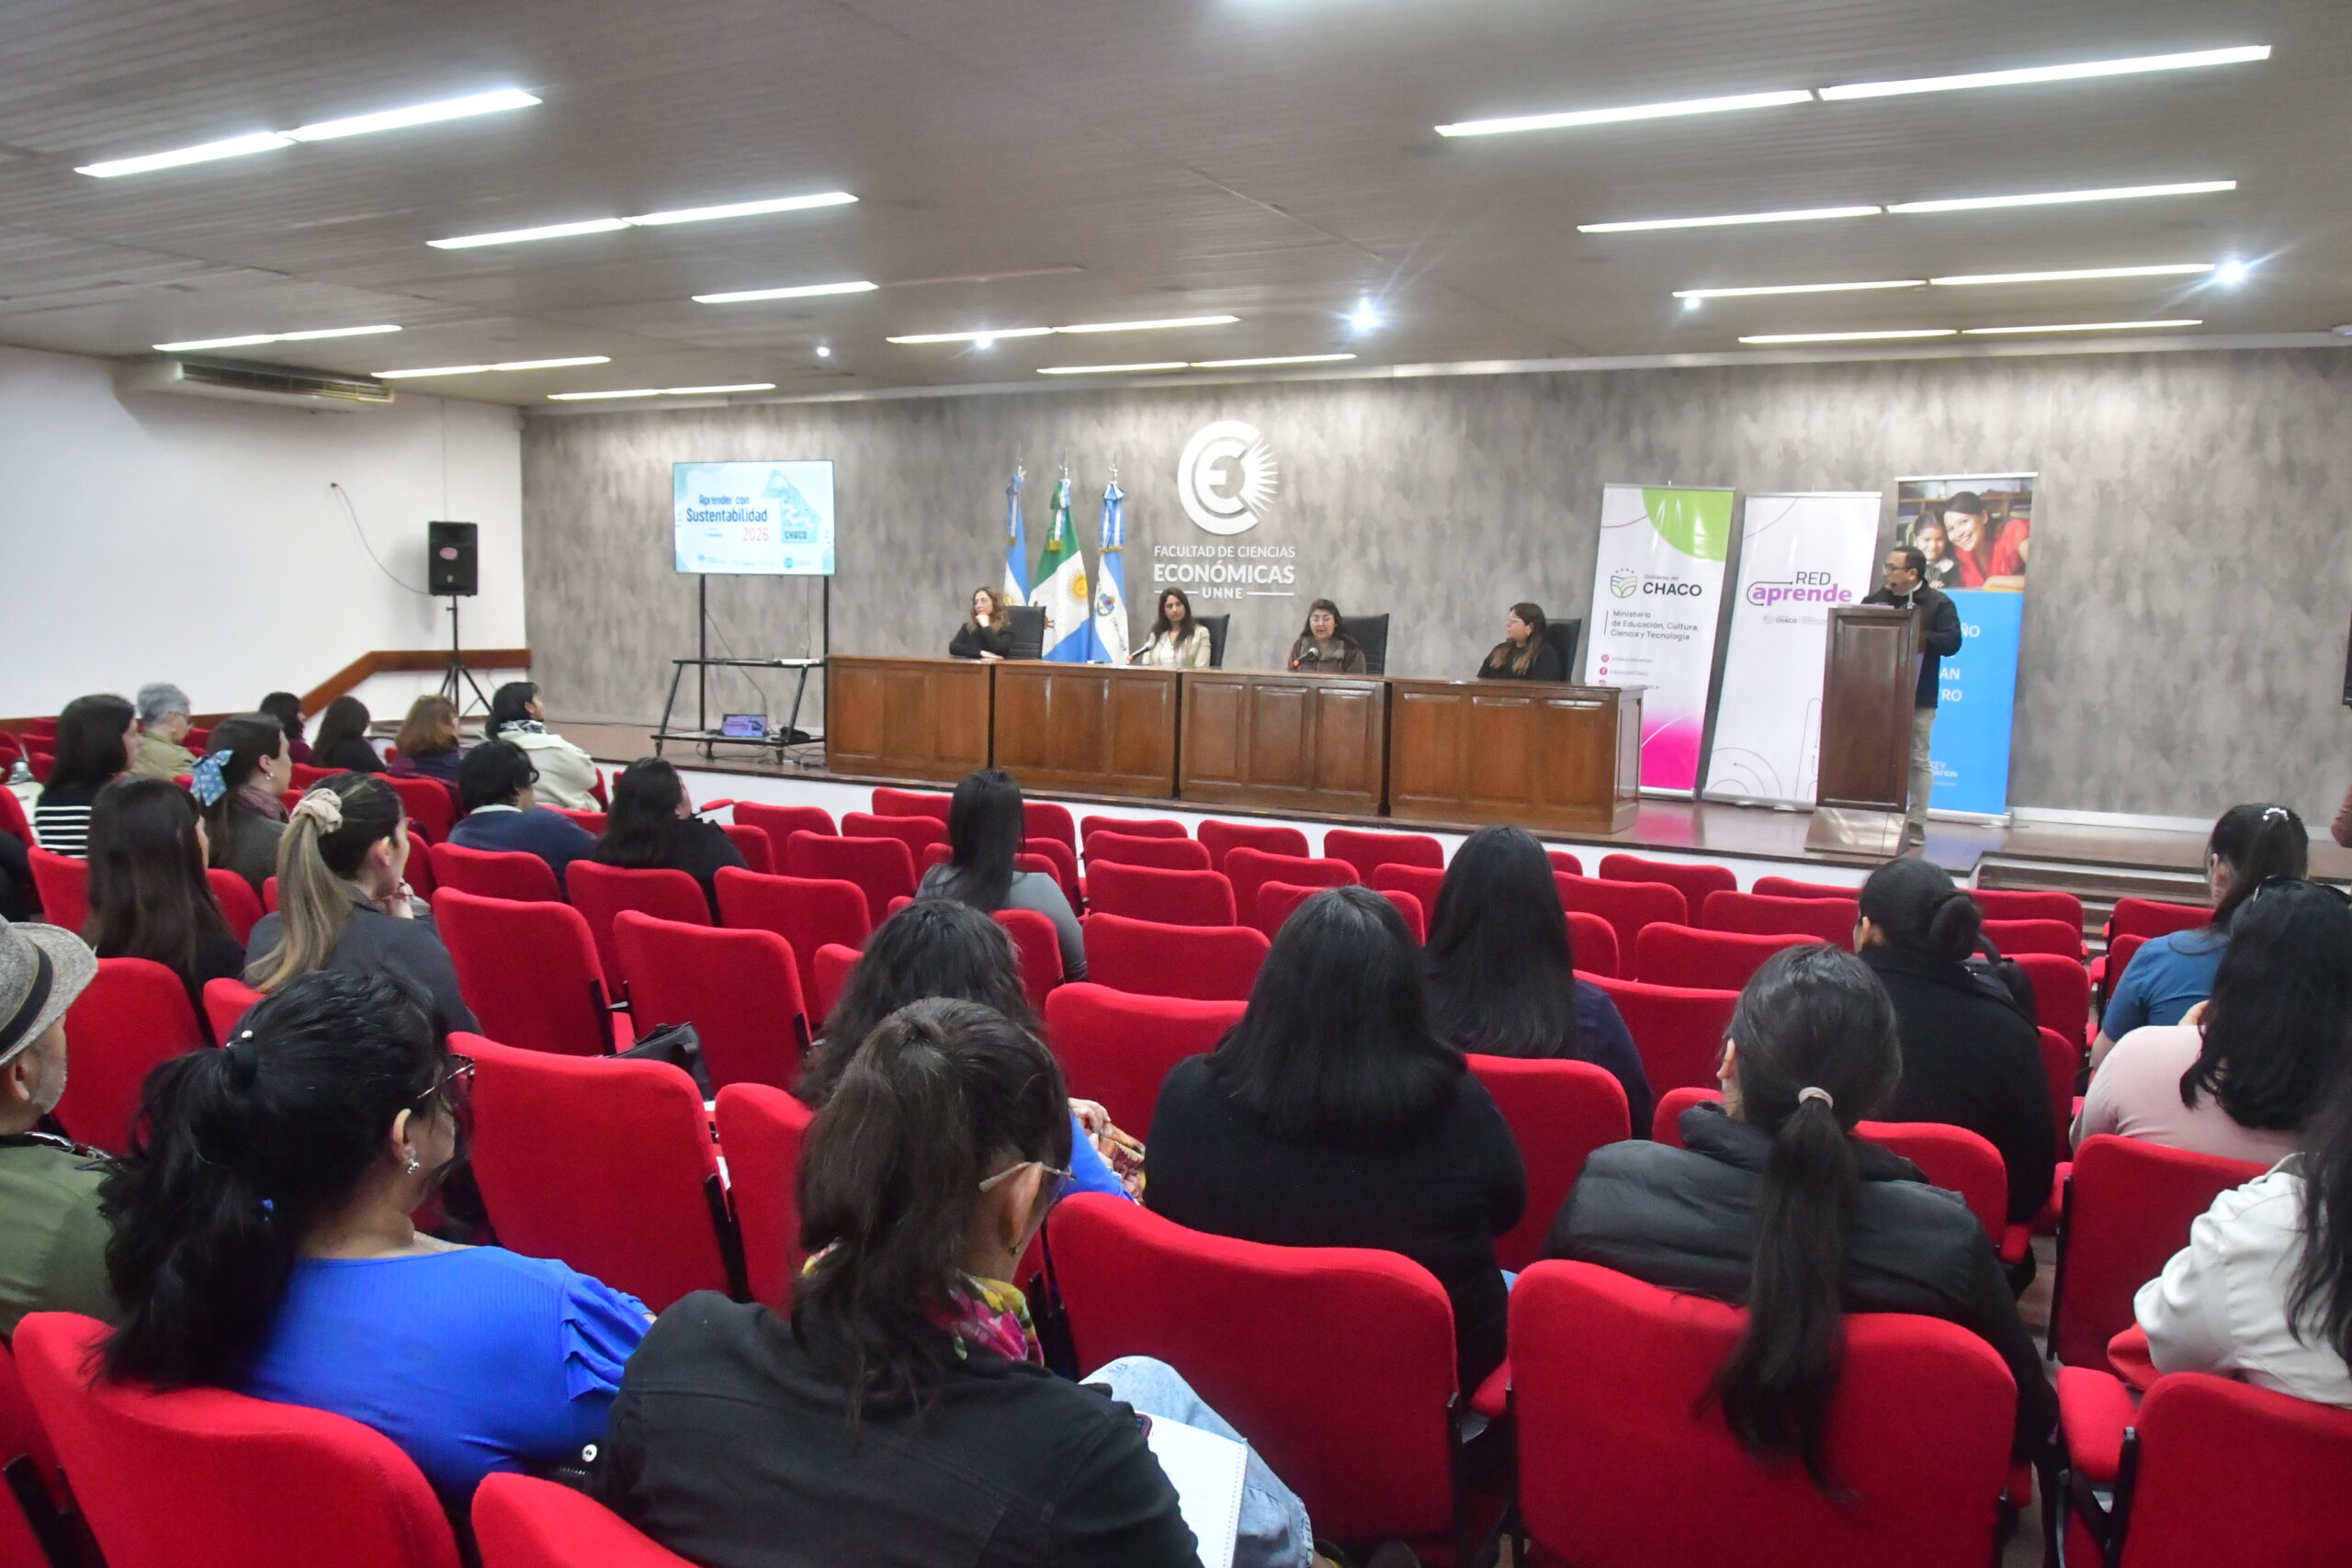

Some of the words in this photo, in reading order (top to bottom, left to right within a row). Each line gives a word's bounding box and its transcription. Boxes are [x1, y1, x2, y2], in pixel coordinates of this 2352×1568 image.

[698, 494, 732, 507] Aprender
[735, 495, 750, 505] con
[686, 508, 768, 523] Sustentabilidad
[742, 527, 769, 542] 2026
[1154, 545, 1216, 558] FACULTAD
[1217, 546, 1235, 558] DE
[1238, 546, 1295, 558] CIENCIAS
[1153, 559, 1295, 584] ECONÓMICAS
[1795, 570, 1832, 586] RED
[1202, 587, 1243, 600] UNNE
[1642, 581, 1702, 597] CHACO
[1752, 583, 1853, 606] aprende
[1612, 610, 1652, 619] Ministerio
[1611, 619, 1622, 627] de
[1622, 620, 1665, 630] Educación,
[1667, 623, 1700, 632] Cultura,
[1960, 622, 1981, 637] ÑO
[1610, 628, 1639, 638] Ciencia
[1645, 631, 1690, 642] Tecnología
[1939, 667, 1961, 681] AN
[1939, 688, 1963, 702] RO
